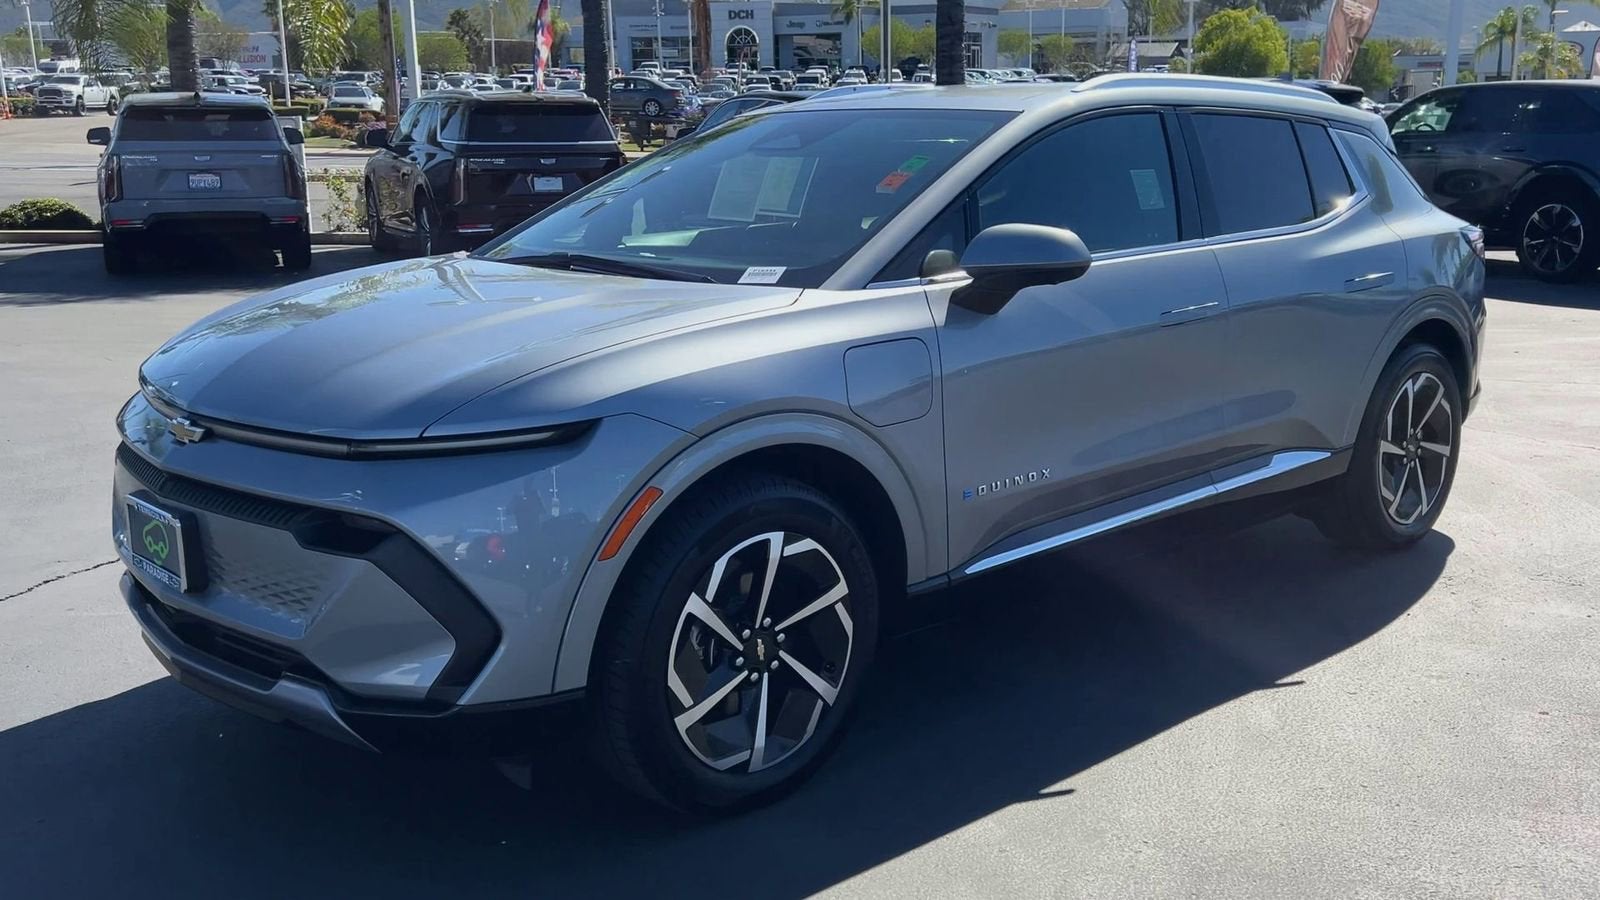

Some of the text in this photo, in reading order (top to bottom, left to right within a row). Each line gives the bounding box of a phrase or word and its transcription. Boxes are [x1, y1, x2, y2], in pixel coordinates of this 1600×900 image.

[728, 9, 755, 20] DCH
[238, 54, 267, 64] LLISION
[962, 468, 1050, 501] EQUINOX
